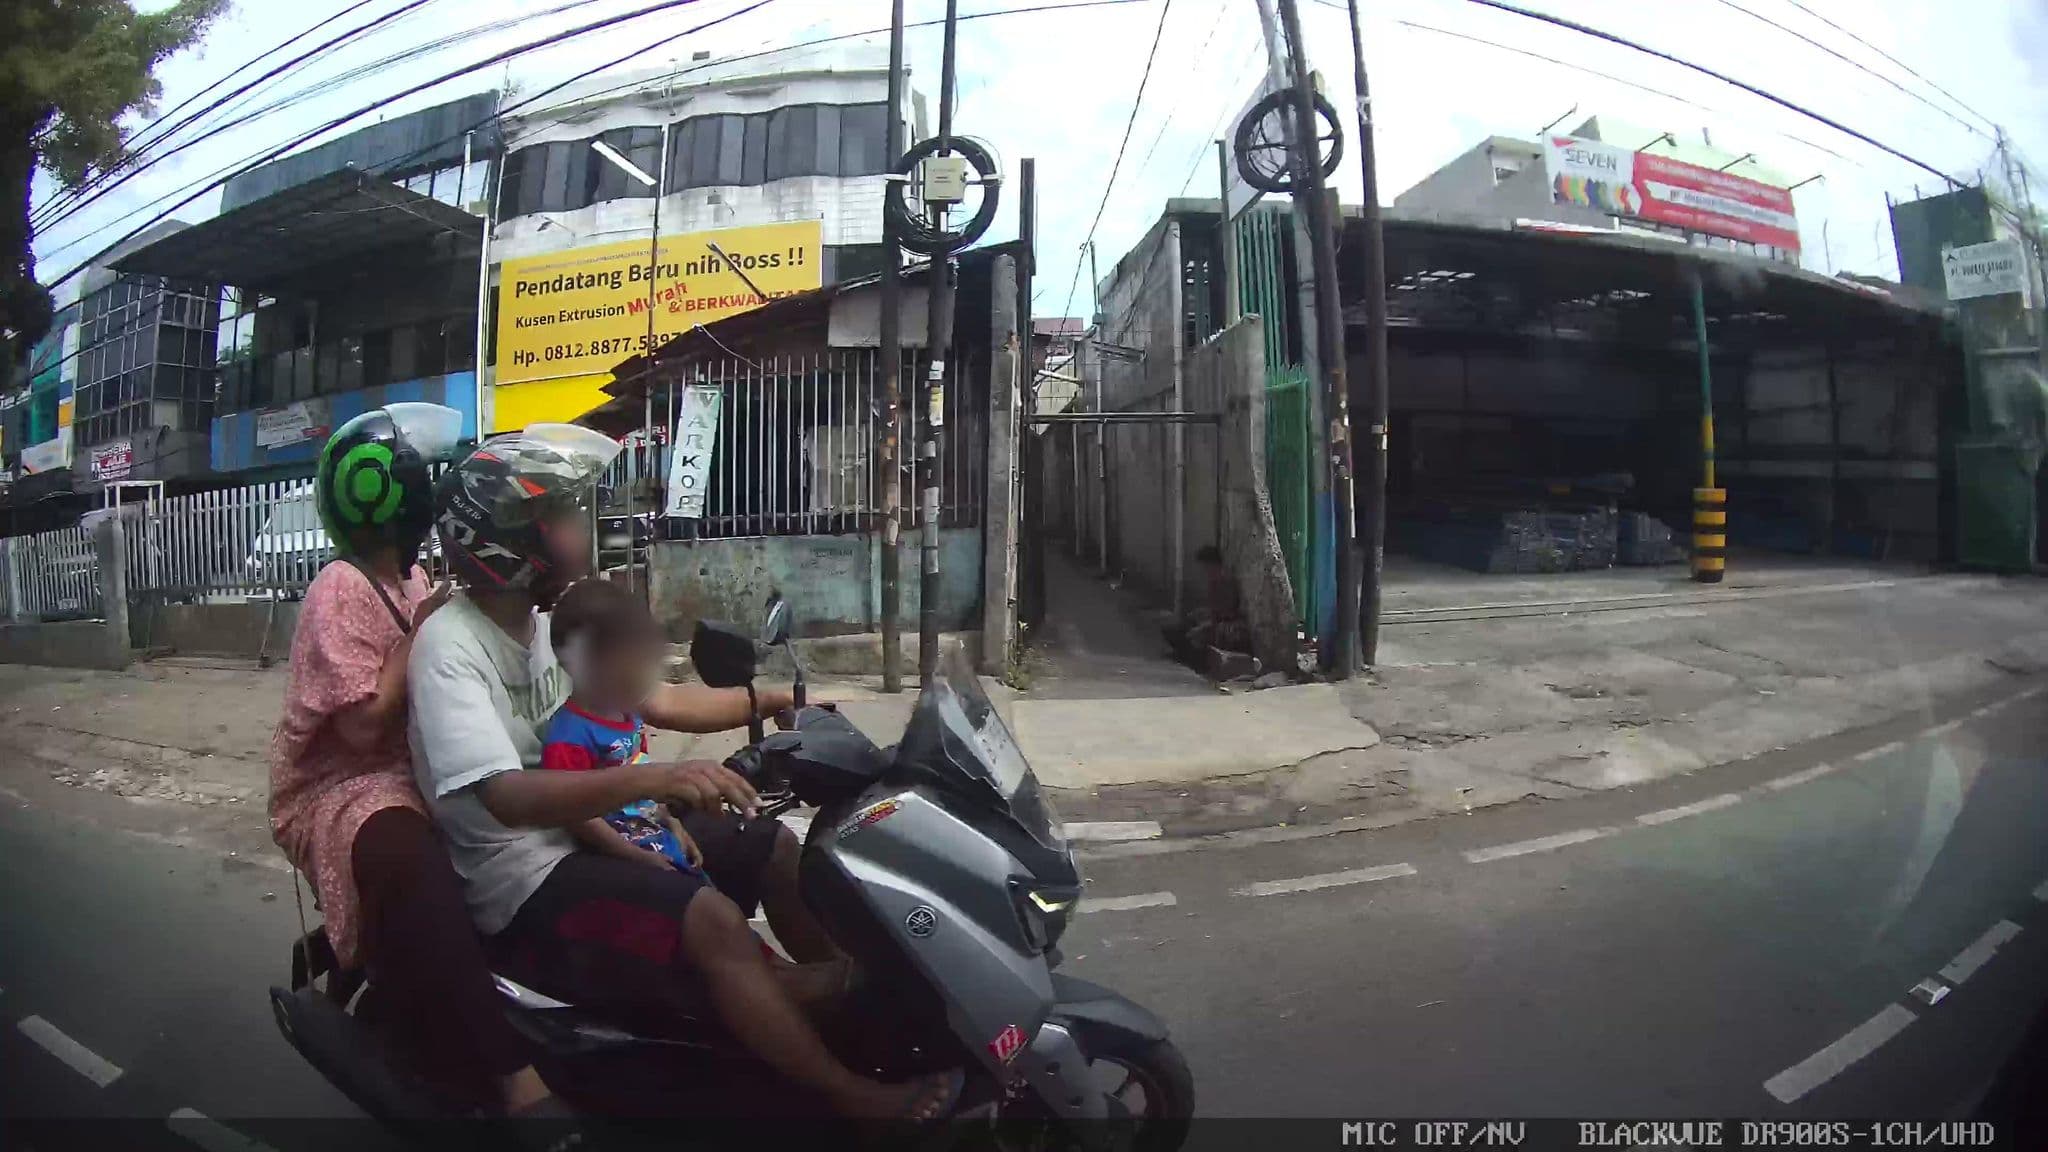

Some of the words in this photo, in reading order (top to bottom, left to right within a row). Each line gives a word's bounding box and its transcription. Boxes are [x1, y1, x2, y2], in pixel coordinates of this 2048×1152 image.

[1565, 149, 1617, 171] SEVEN
[516, 270, 622, 298] Pendatang
[628, 262, 678, 282] Baru
[686, 254, 720, 276] nih
[728, 251, 780, 273] Boss
[788, 246, 804, 266] !!
[627, 281, 688, 316] Murah
[516, 312, 555, 329] Kusen
[559, 303, 625, 324] Extrusion
[514, 350, 540, 367] Hp.
